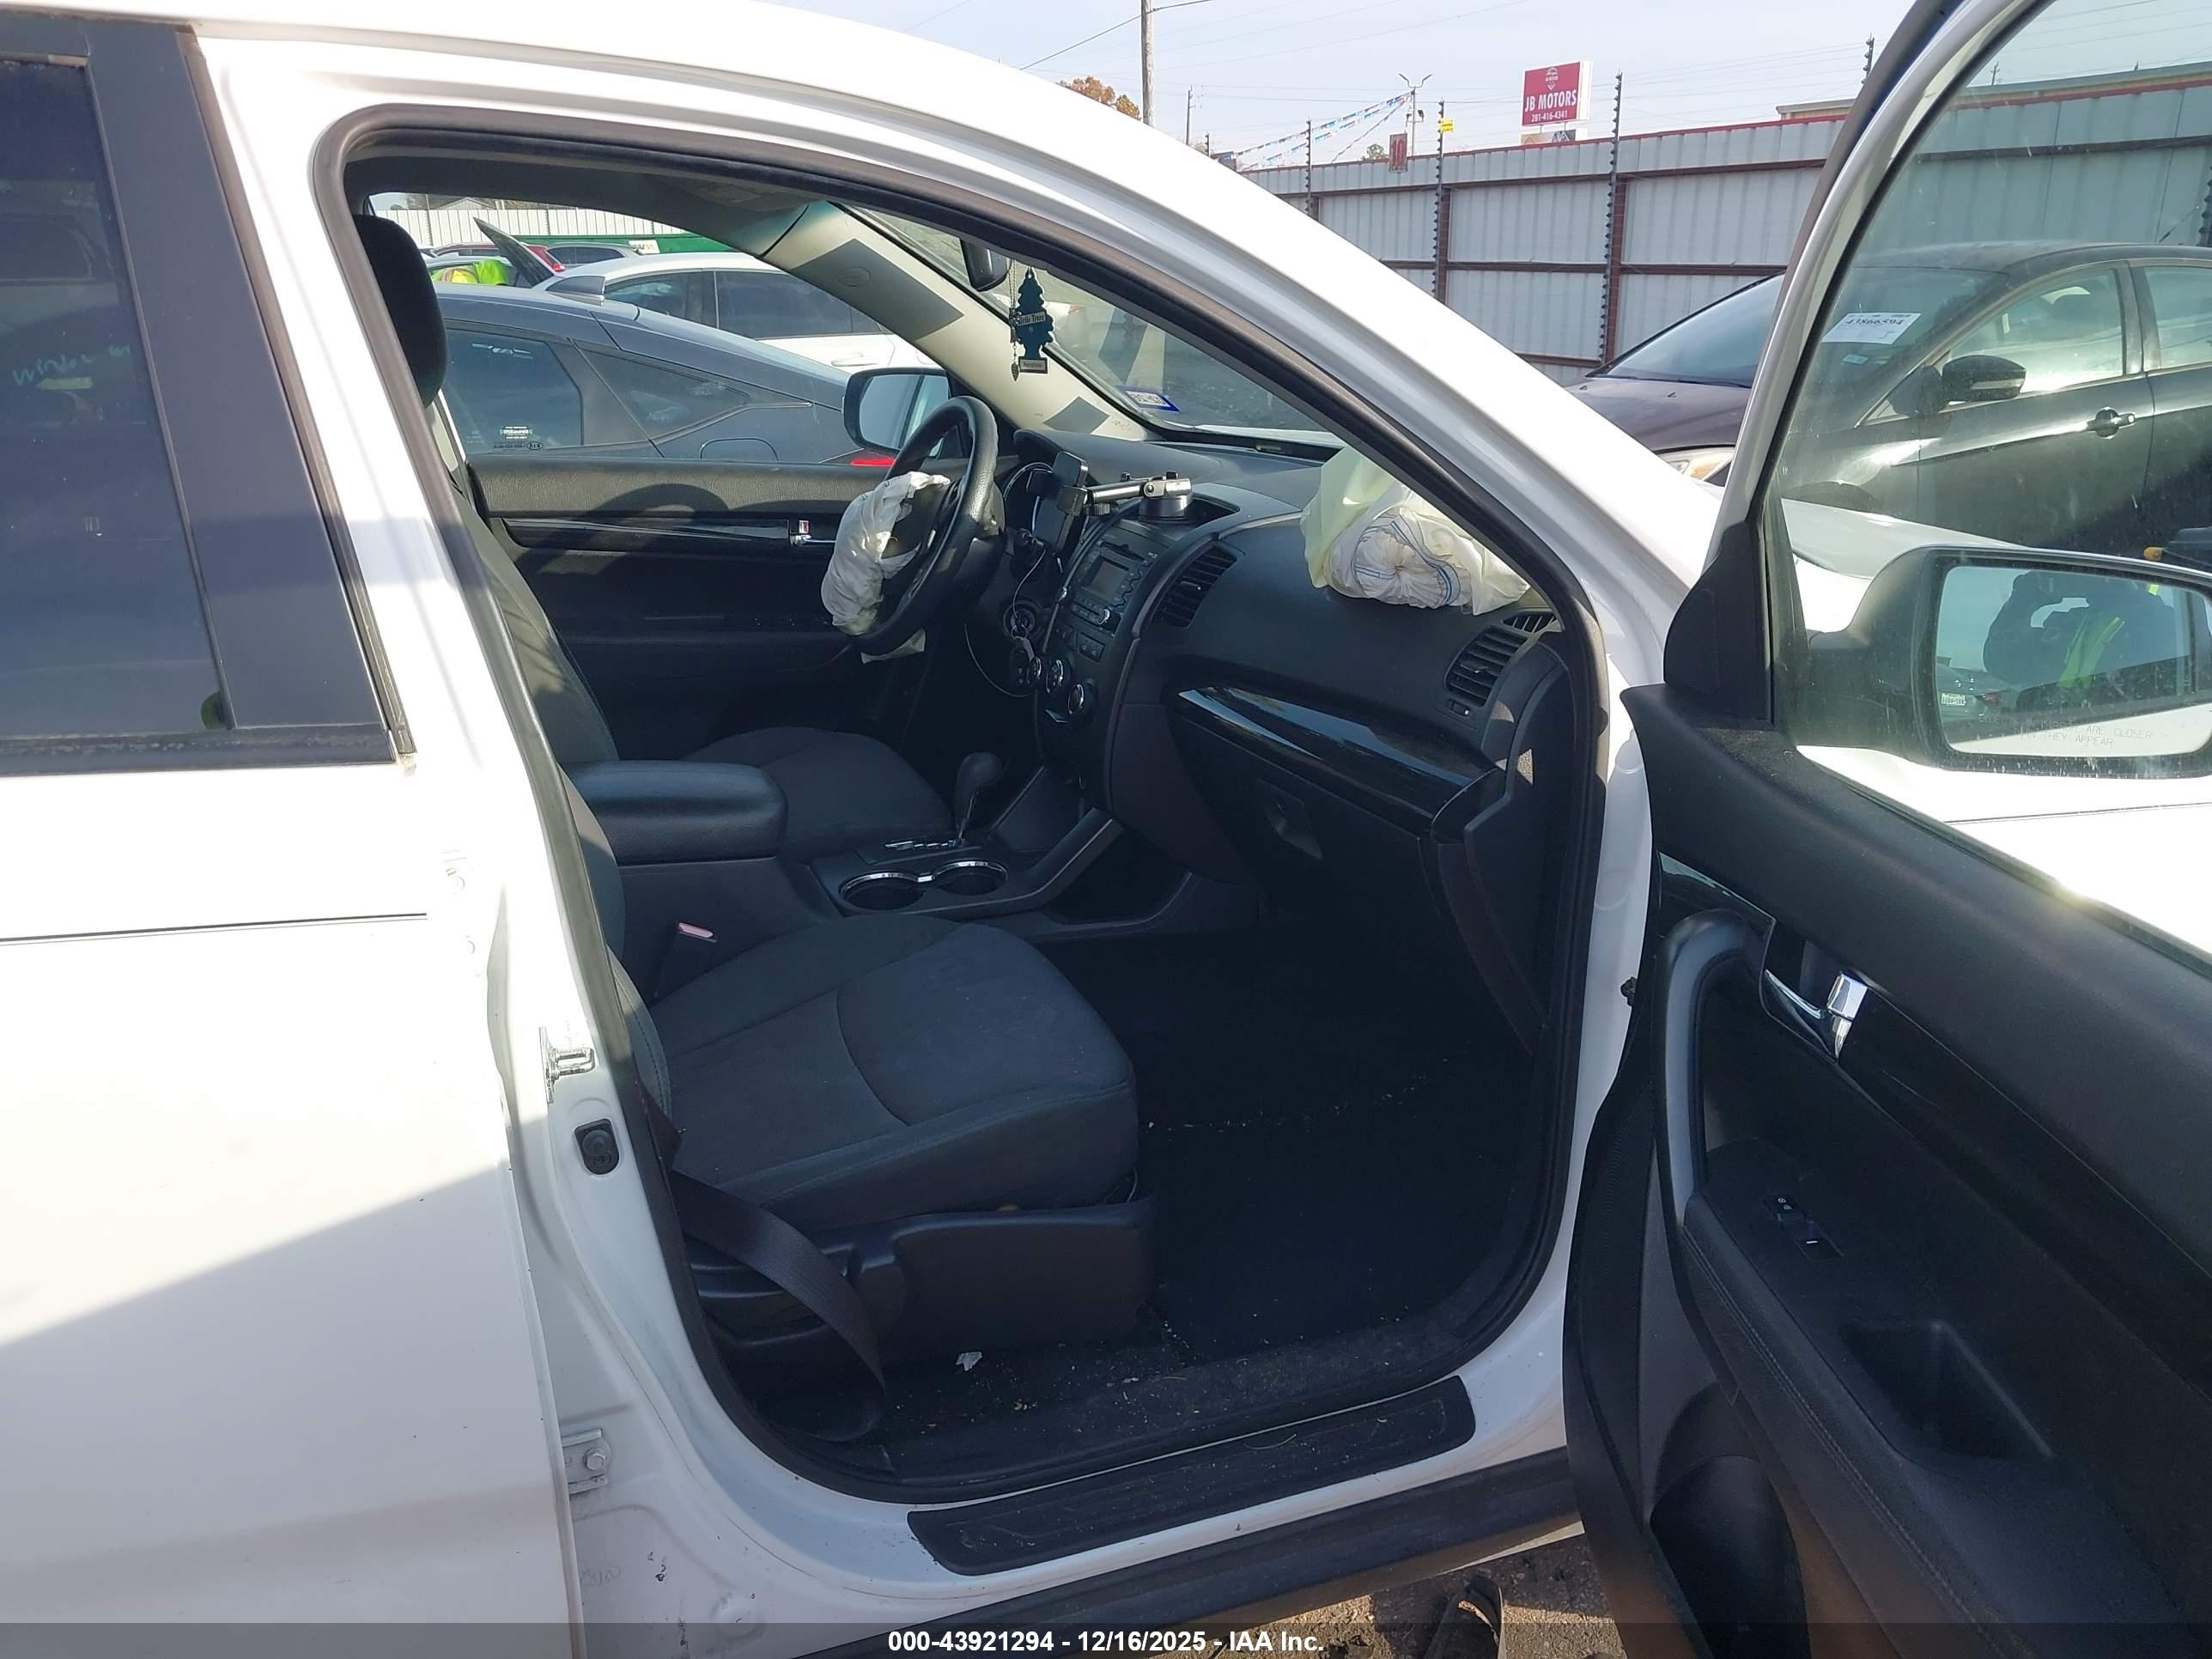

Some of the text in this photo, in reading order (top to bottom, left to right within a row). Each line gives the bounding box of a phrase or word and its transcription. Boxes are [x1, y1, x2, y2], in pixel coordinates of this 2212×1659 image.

[1525, 90, 1577, 112] JB MOTORS
[2086, 726, 2104, 735] ARE
[2113, 728, 2153, 739] CLOSER
[2075, 735, 2114, 745] APPEAR
